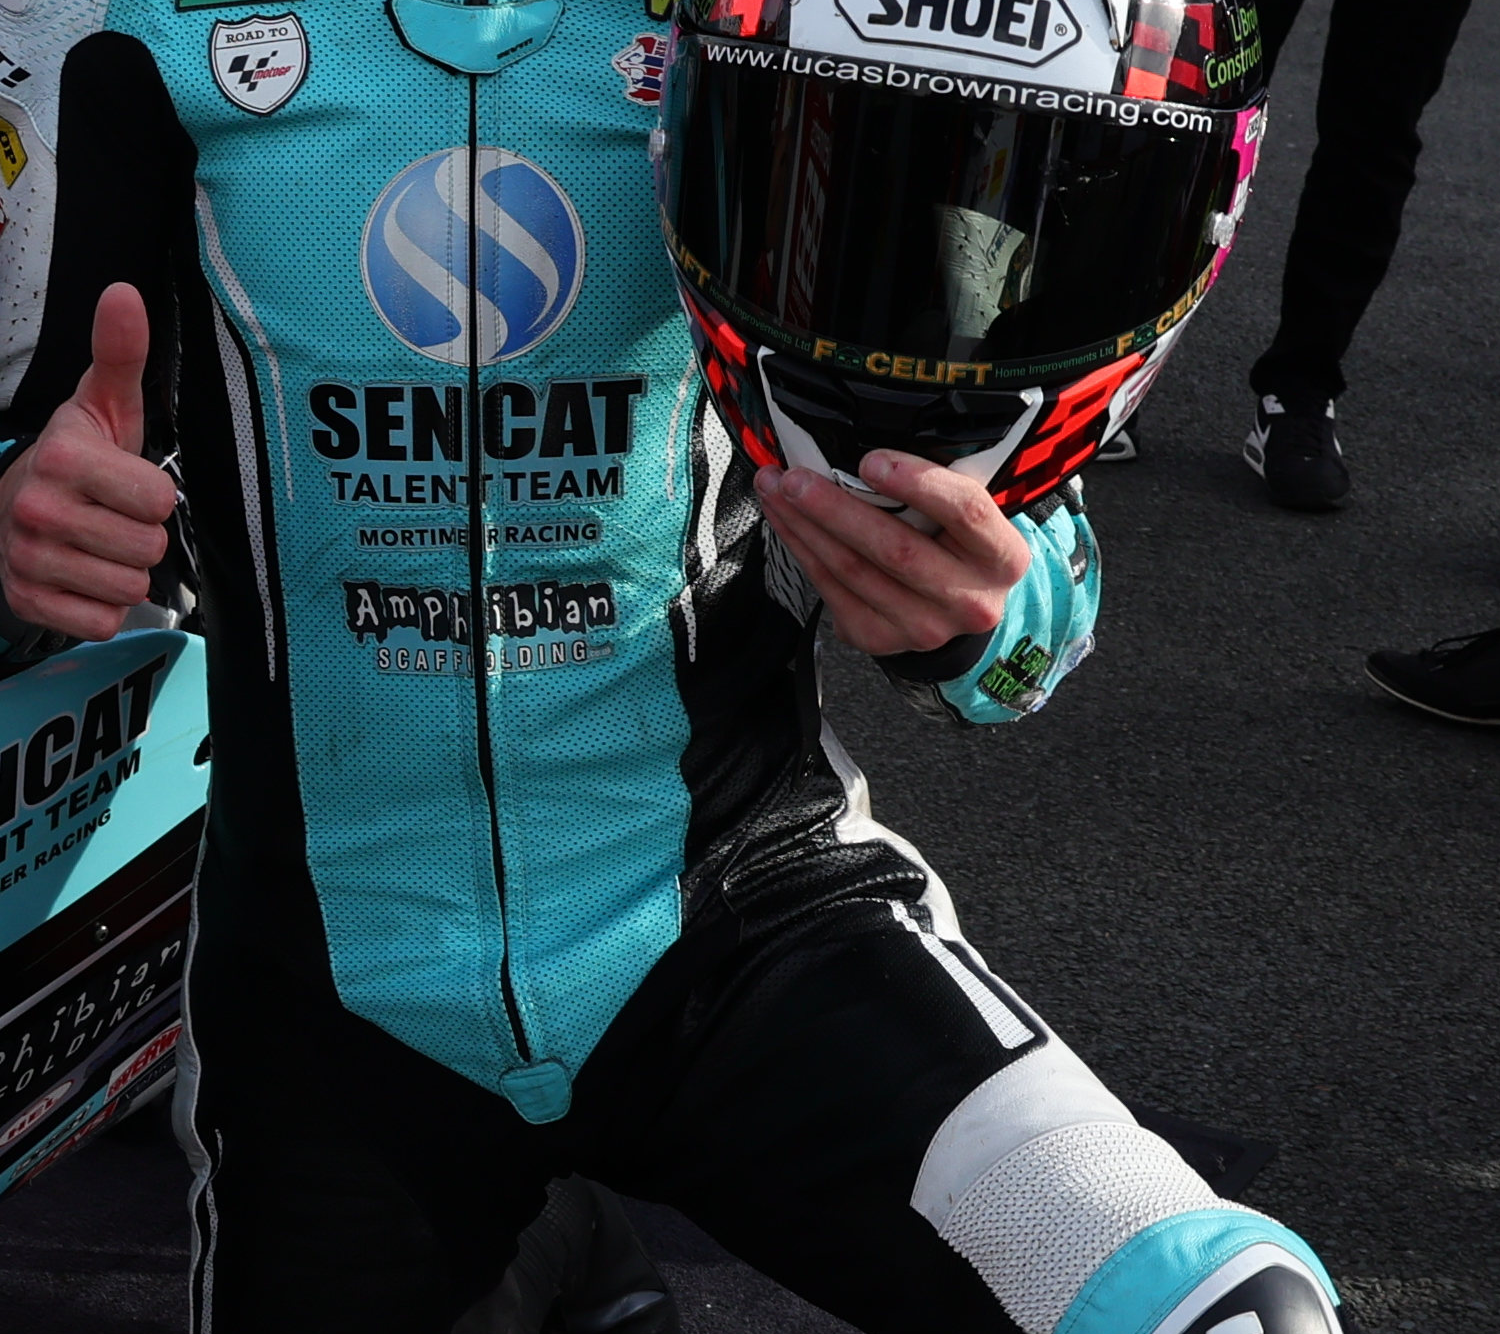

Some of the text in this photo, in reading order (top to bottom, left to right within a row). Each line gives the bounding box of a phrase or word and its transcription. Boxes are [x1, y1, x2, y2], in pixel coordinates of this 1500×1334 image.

[225, 27, 289, 44] ROAD TO
[705, 44, 1214, 134] www.lucasbrownracing.com
[309, 378, 644, 463] SENCAT
[331, 467, 620, 503] TALENT TEAM
[359, 523, 598, 547] MORTIMER RACING
[355, 586, 611, 639] Amphibian
[42, 745, 143, 831] TEAM
[33, 806, 114, 874] RACING
